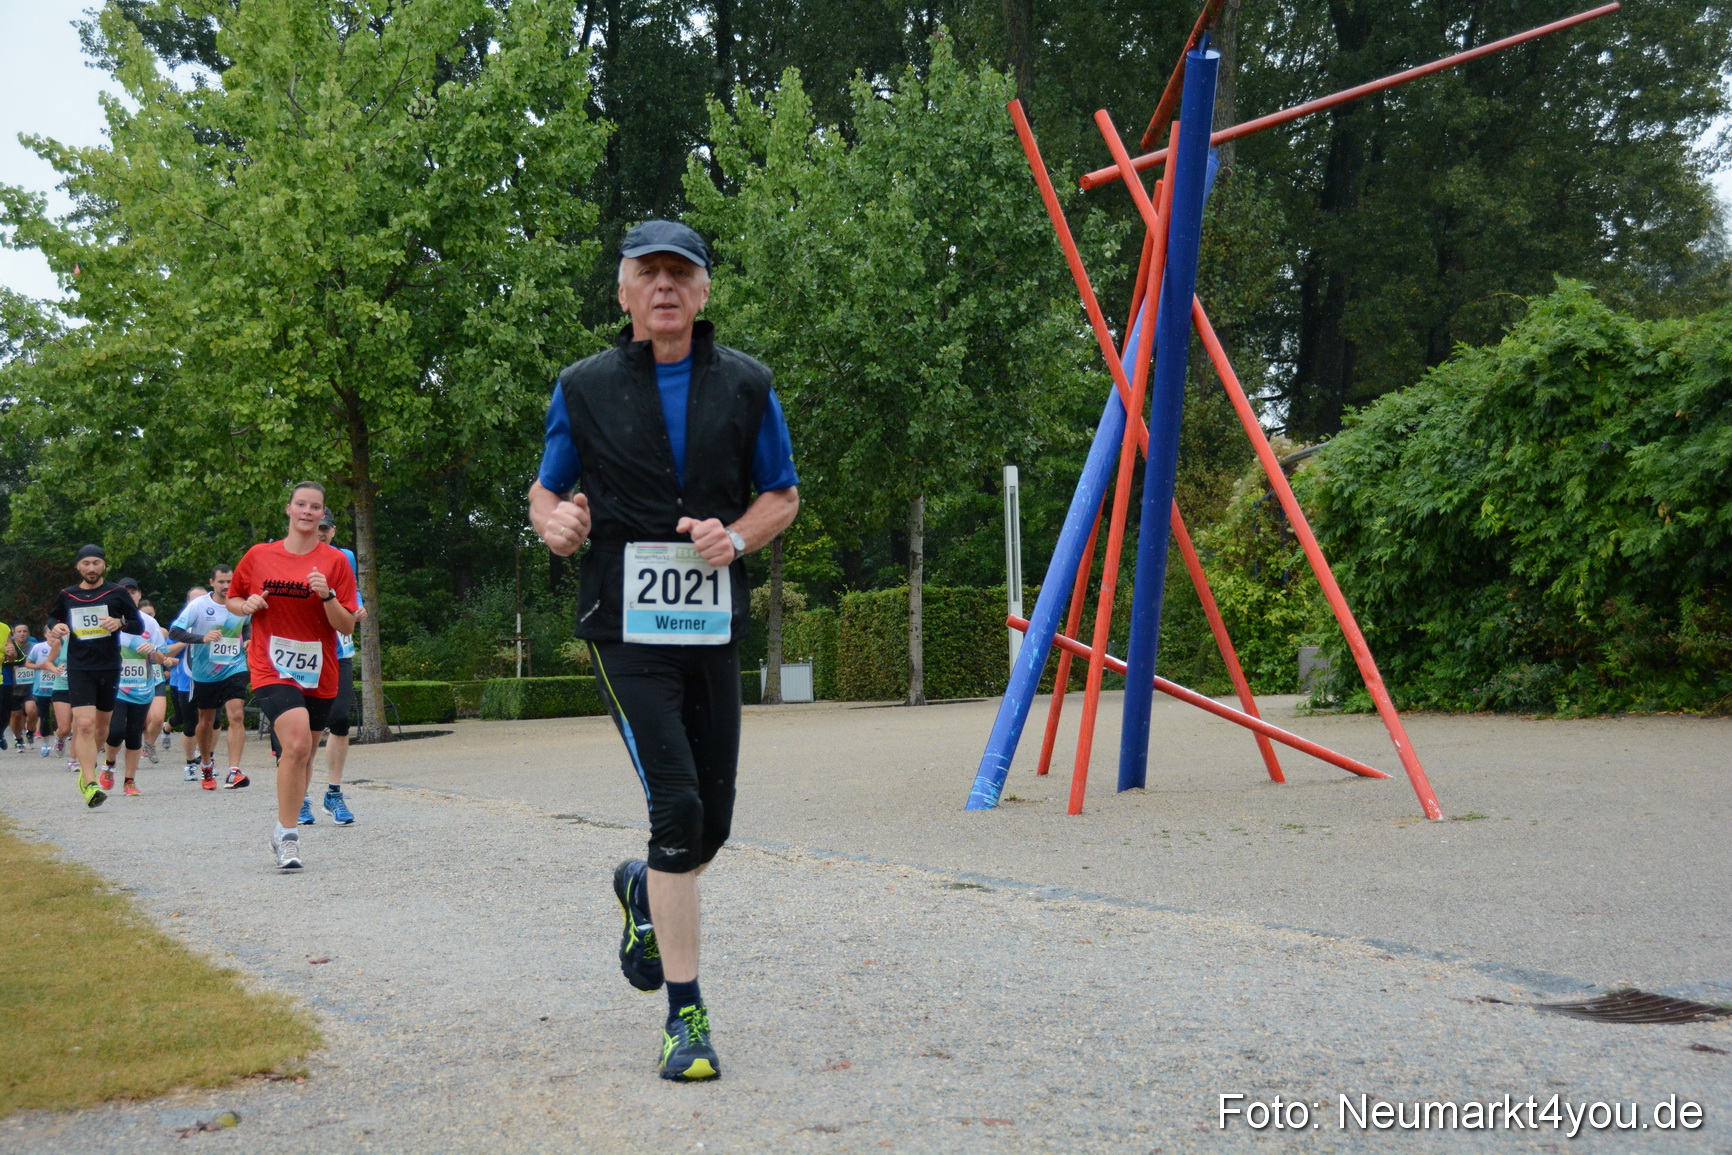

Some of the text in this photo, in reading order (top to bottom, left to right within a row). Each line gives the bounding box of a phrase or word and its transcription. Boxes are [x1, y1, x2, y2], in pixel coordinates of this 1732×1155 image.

[637, 568, 719, 606] 2021
[82, 614, 99, 627] 59
[655, 615, 707, 631] Werner
[213, 643, 238, 655] 2015
[274, 648, 318, 671] 2754
